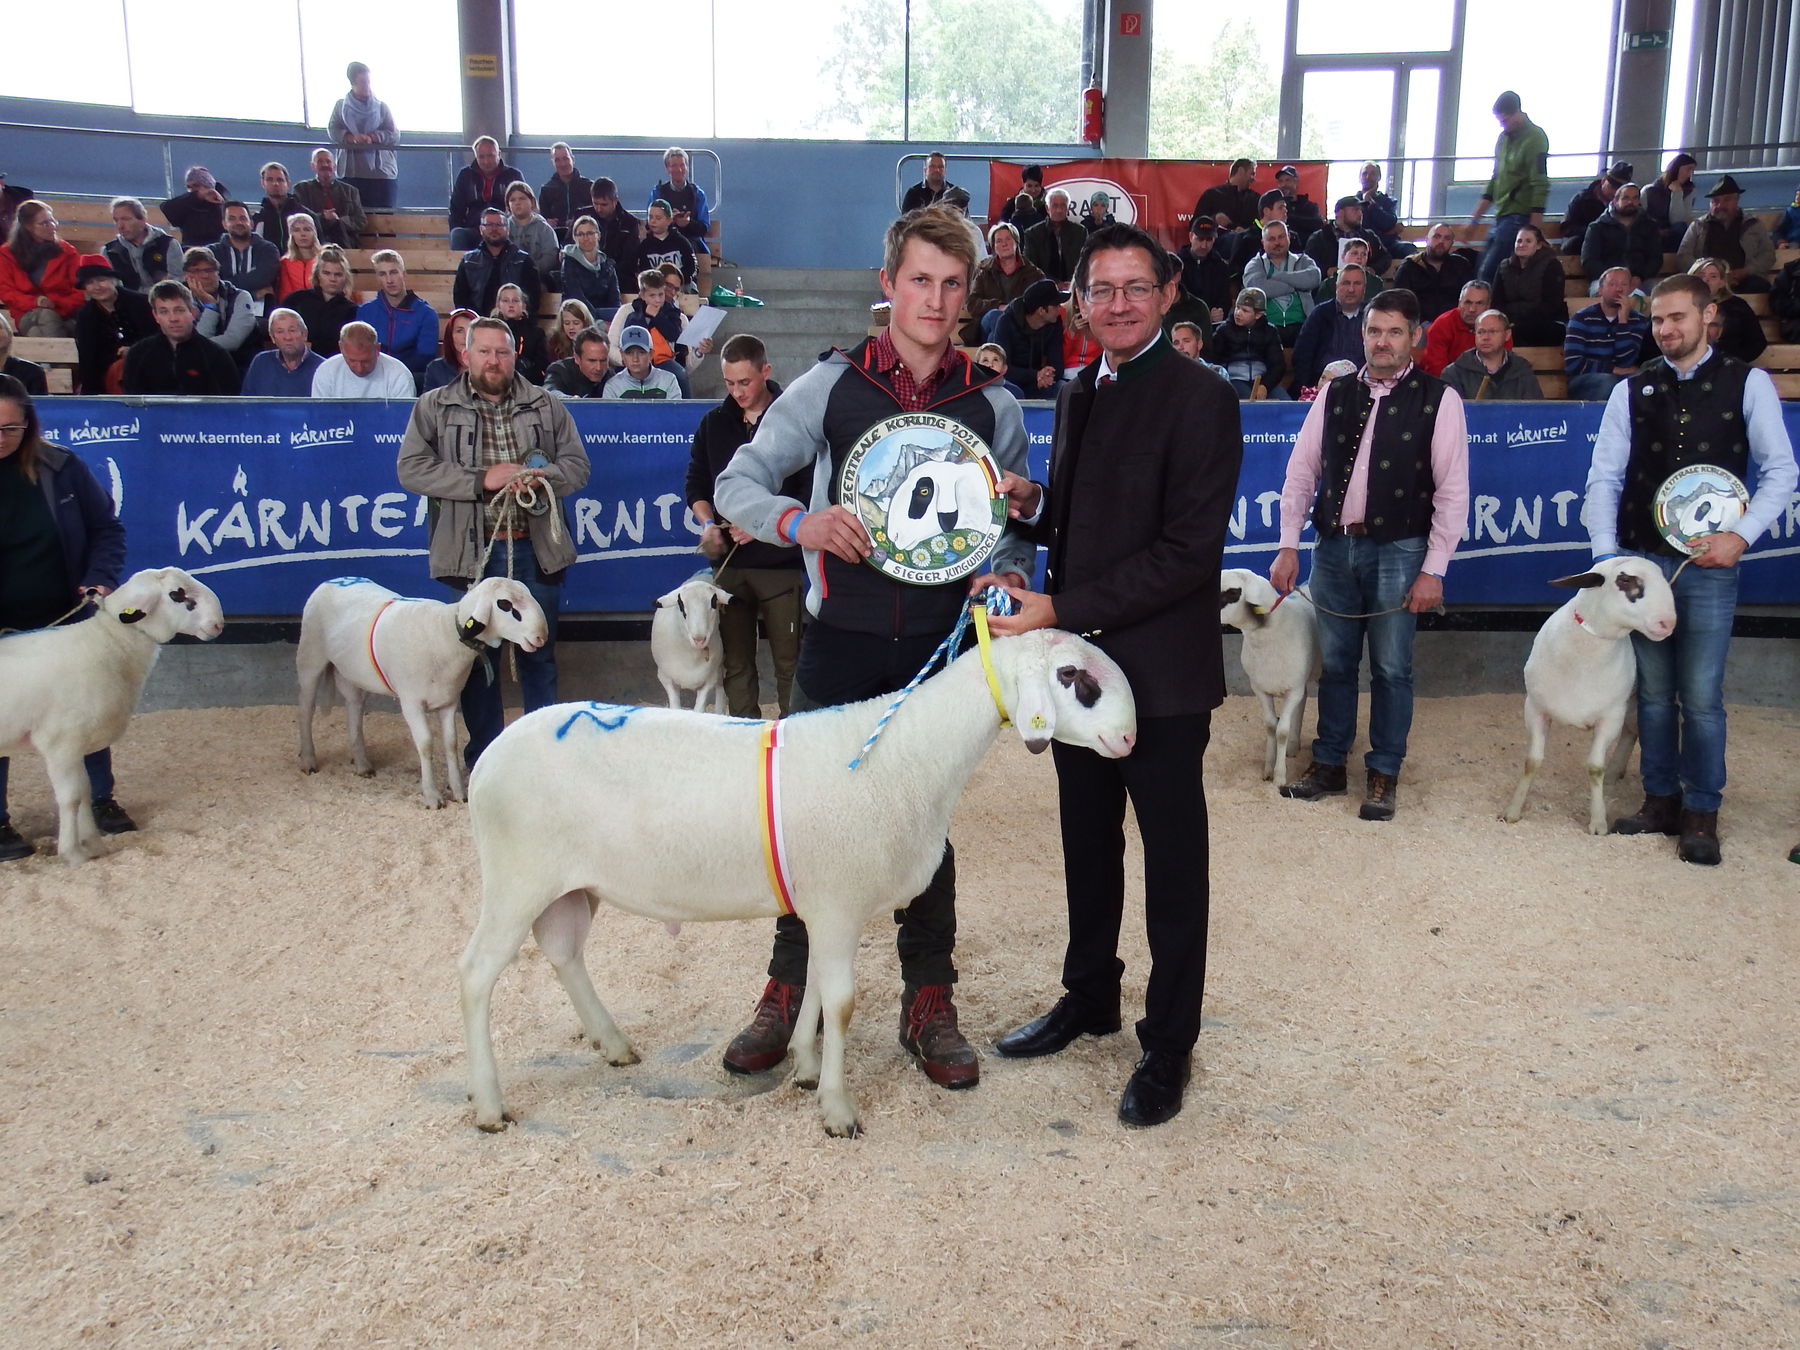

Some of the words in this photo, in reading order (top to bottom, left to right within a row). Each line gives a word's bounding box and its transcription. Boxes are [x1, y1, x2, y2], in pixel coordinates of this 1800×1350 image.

[160, 431, 281, 444] www.kaernten.at
[584, 431, 695, 444] www.kaernten.a
[841, 431, 881, 506] ZENTRALE
[951, 425, 980, 449] 2021
[892, 565, 942, 582] SIEGER
[944, 532, 998, 582] JUNGWIDDER
